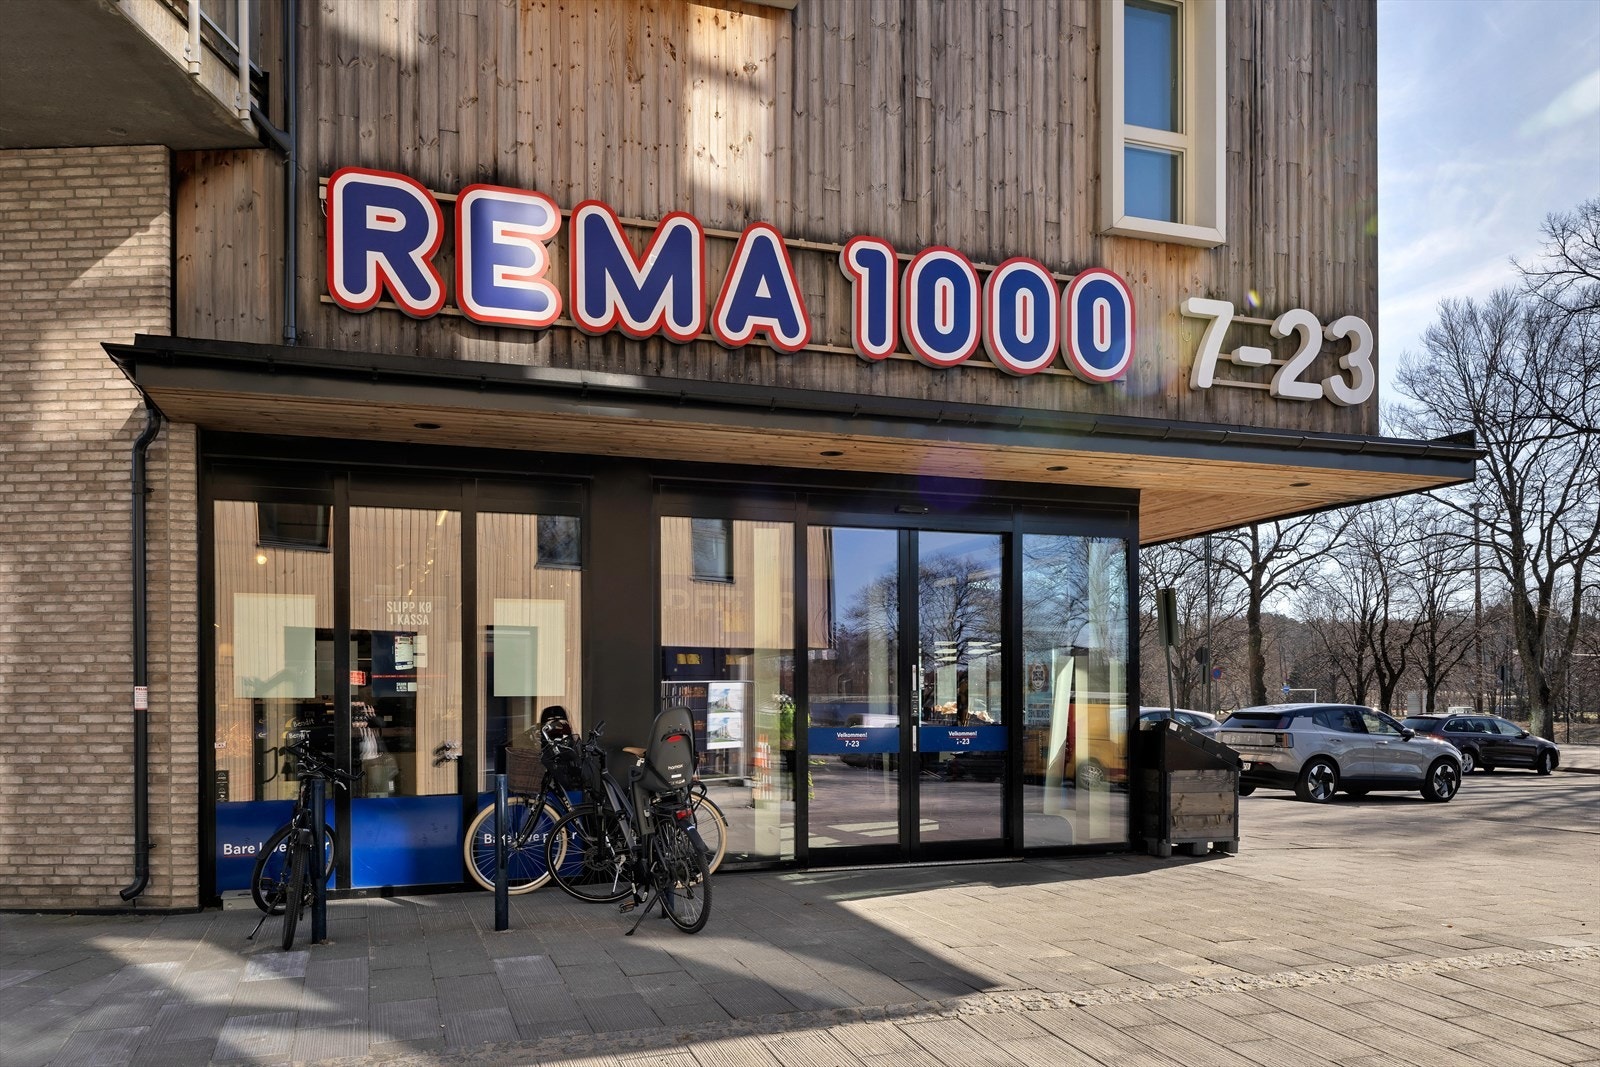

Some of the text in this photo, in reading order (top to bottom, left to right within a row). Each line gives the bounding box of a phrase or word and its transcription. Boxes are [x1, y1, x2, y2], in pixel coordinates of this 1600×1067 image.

[327, 166, 1136, 384] REMA 1000
[1180, 297, 1375, 406] 7-23
[386, 601, 432, 614] SLIPP KØ
[397, 614, 429, 625] KASSA
[845, 740, 860, 748] 7-23
[223, 843, 256, 855] Bare
